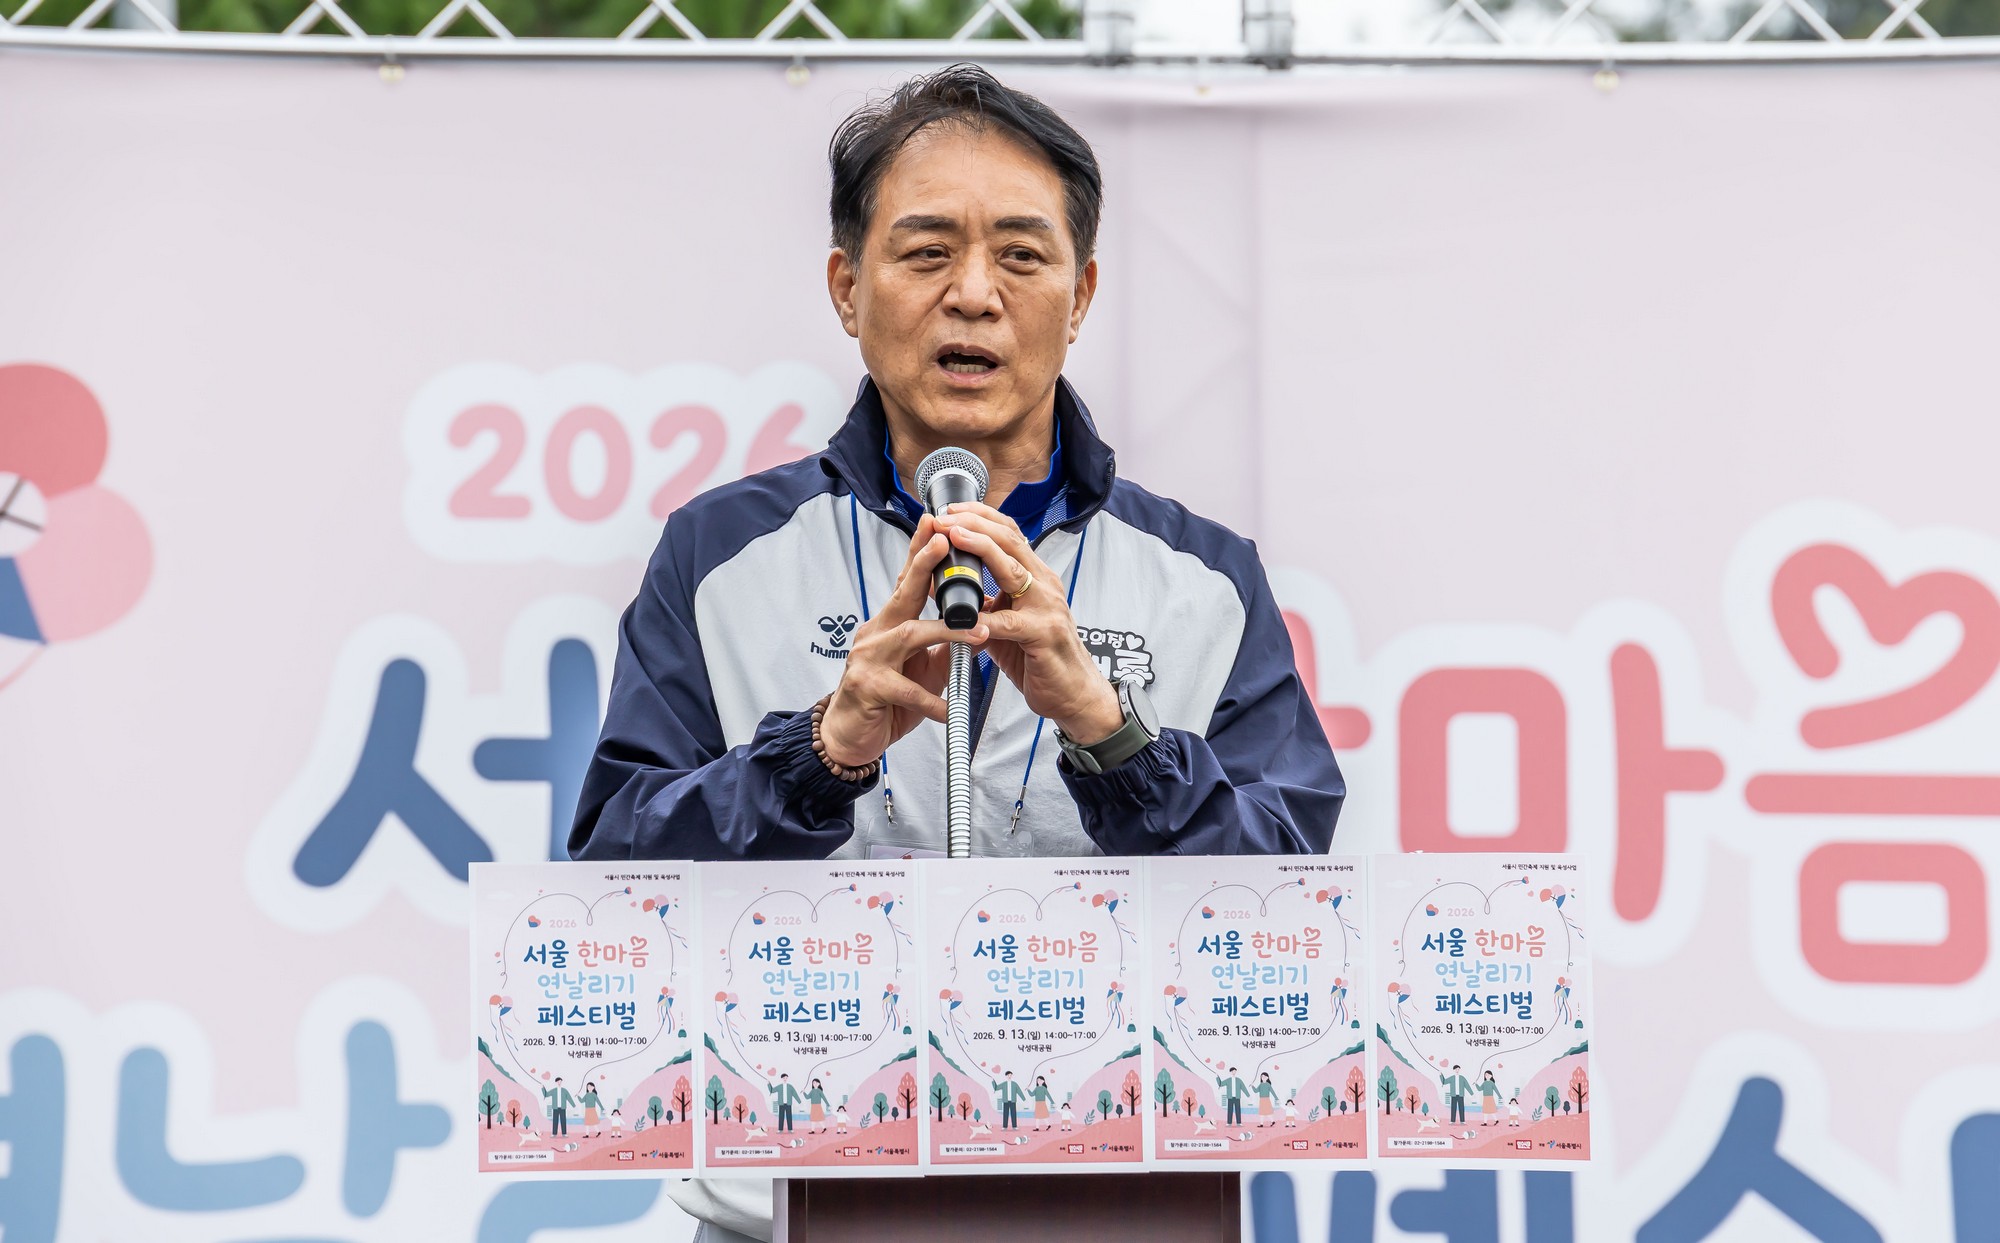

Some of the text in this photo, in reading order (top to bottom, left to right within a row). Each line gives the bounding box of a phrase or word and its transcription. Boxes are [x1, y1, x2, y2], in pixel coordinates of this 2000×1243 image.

[810, 641, 850, 660] humm
[292, 542, 2000, 986] 서 마음
[549, 919, 577, 928] 2026
[774, 916, 801, 925] 2026
[998, 914, 1026, 922] 2026
[1223, 910, 1250, 919] 2026
[1447, 907, 1474, 916] 2026
[523, 935, 649, 968] 서울 한마음
[748, 932, 874, 965] 서울 한마음
[973, 930, 1098, 963] 서울 한마음
[1197, 926, 1322, 959] 서울 한마음
[1421, 924, 1546, 957] 서울 한마음
[537, 970, 634, 999] 연날리기
[762, 967, 859, 996] 연날리기
[987, 965, 1083, 994] 연날리기
[1211, 961, 1307, 990] 연날리기
[1435, 959, 1531, 989] 연날리기
[537, 1001, 635, 1030] 페스티벌
[762, 998, 860, 1026] 페스티벌
[987, 996, 1084, 1024] 페스티벌
[1211, 992, 1308, 1020] 페스티벌
[1435, 989, 1532, 1019] 페스티벌
[748, 1034, 770, 1042] 2026.
[1269, 1027, 1320, 1035] 14:00~17:00
[1421, 1025, 1442, 1033] 2026.
[1492, 1026, 1543, 1034] 14:00~17:00
[1465, 1038, 1499, 1046] 낙성대공원
[568, 1050, 602, 1058] 낙성대공원
[793, 1046, 827, 1054] 낙성대공원
[1018, 1044, 1052, 1052] 낙성대공원
[1242, 1040, 1276, 1048] 낙성대공원
